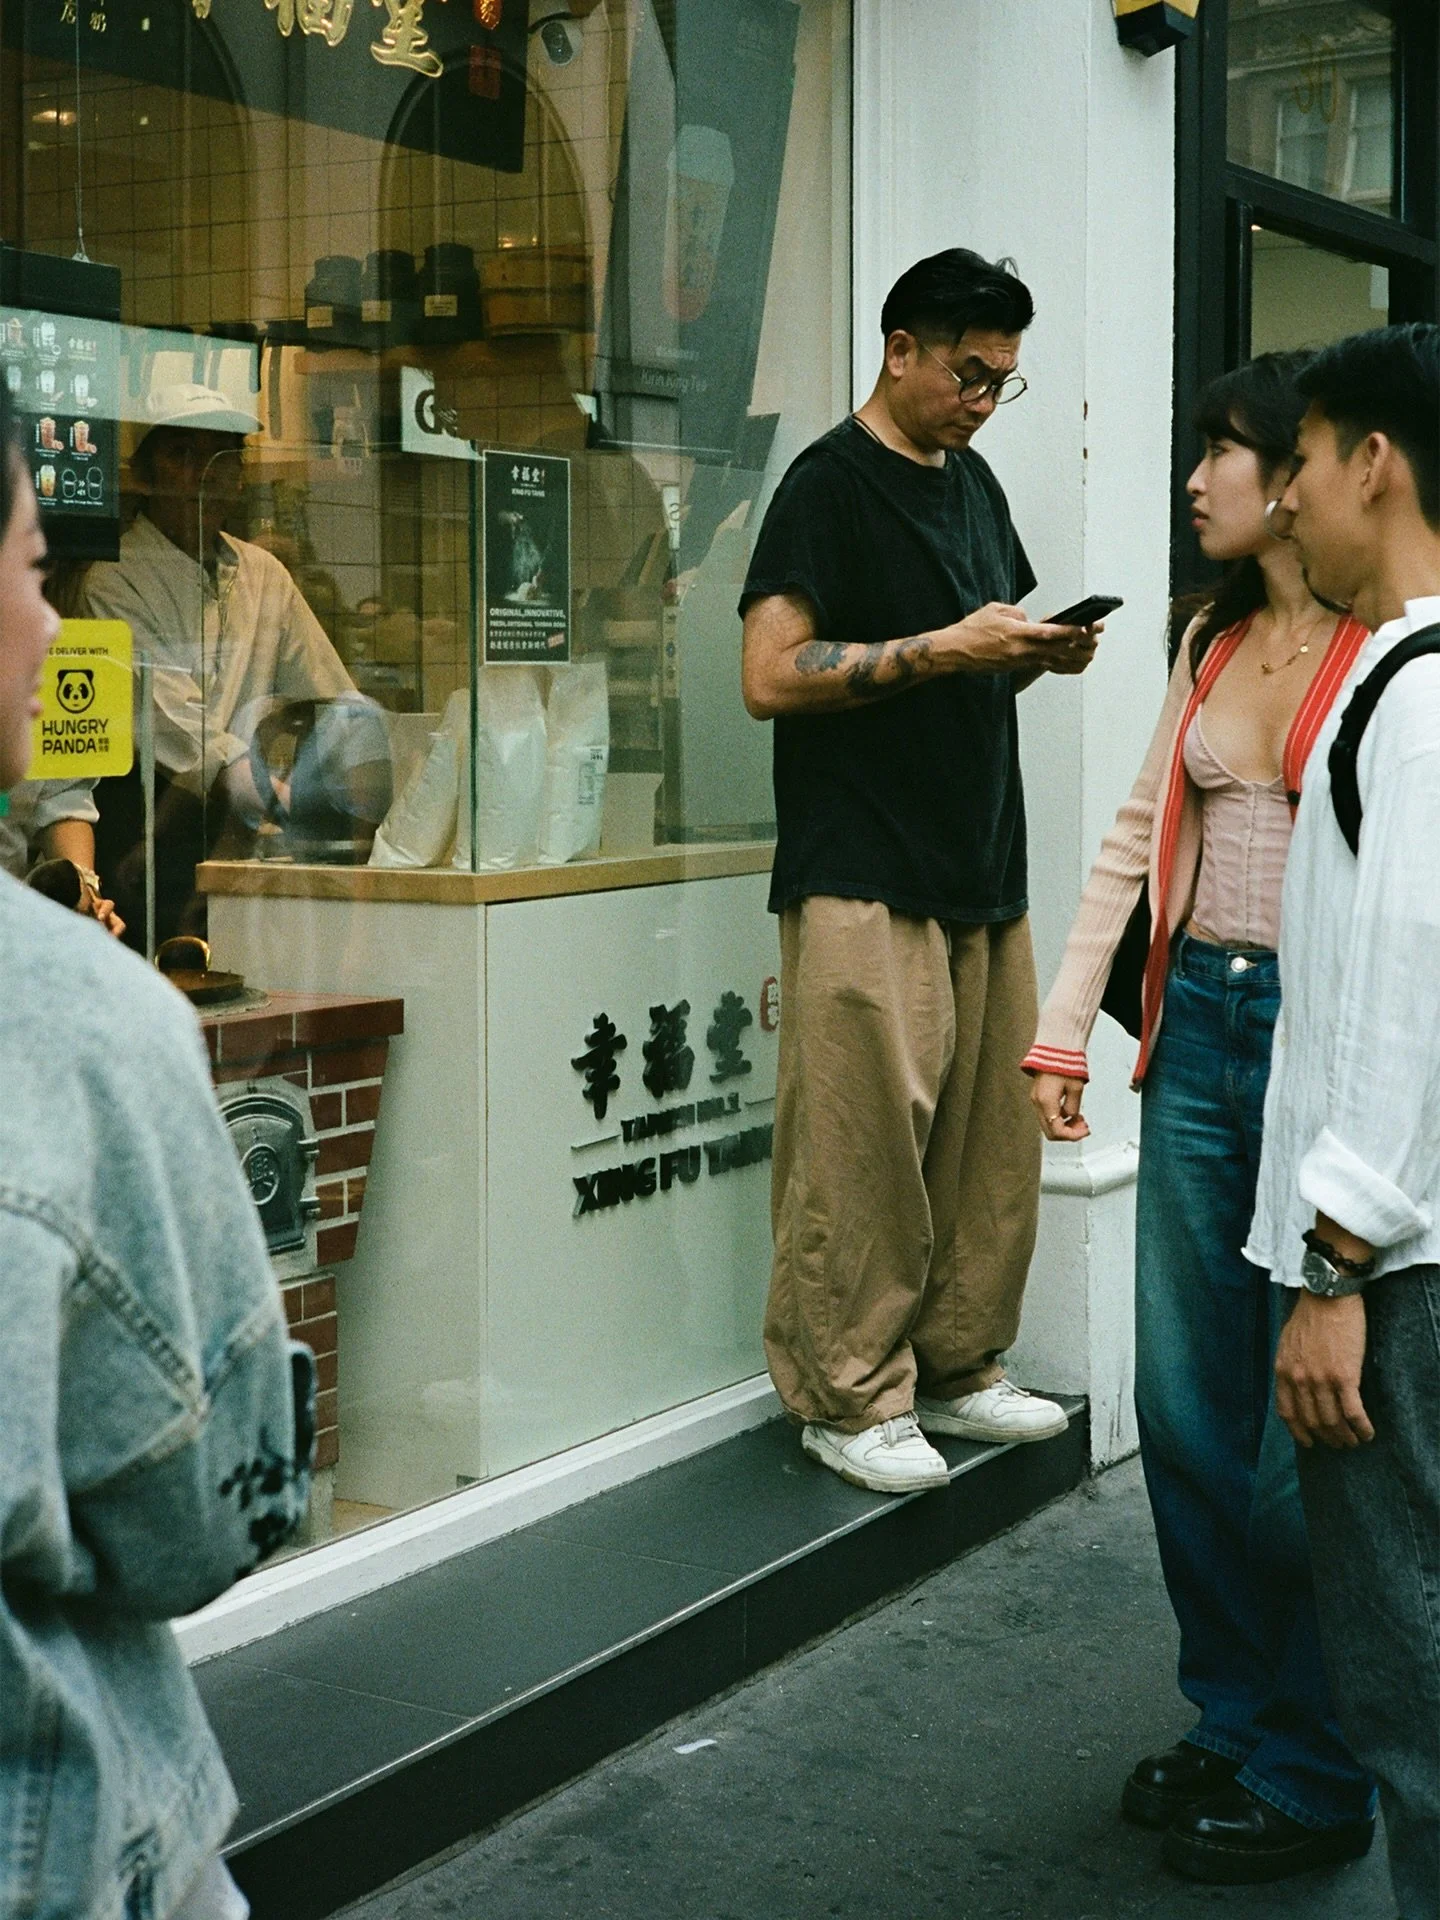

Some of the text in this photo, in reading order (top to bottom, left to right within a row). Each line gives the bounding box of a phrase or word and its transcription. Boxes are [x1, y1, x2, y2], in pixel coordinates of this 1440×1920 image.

[55, 647, 87, 655] DELIVER
[88, 647, 108, 655] WITH
[42, 719, 109, 736] HUNGRY
[42, 738, 97, 755] PANDA
[571, 990, 753, 1120] 幸福堂
[573, 1157, 657, 1216] XING
[660, 1145, 701, 1191] FU
